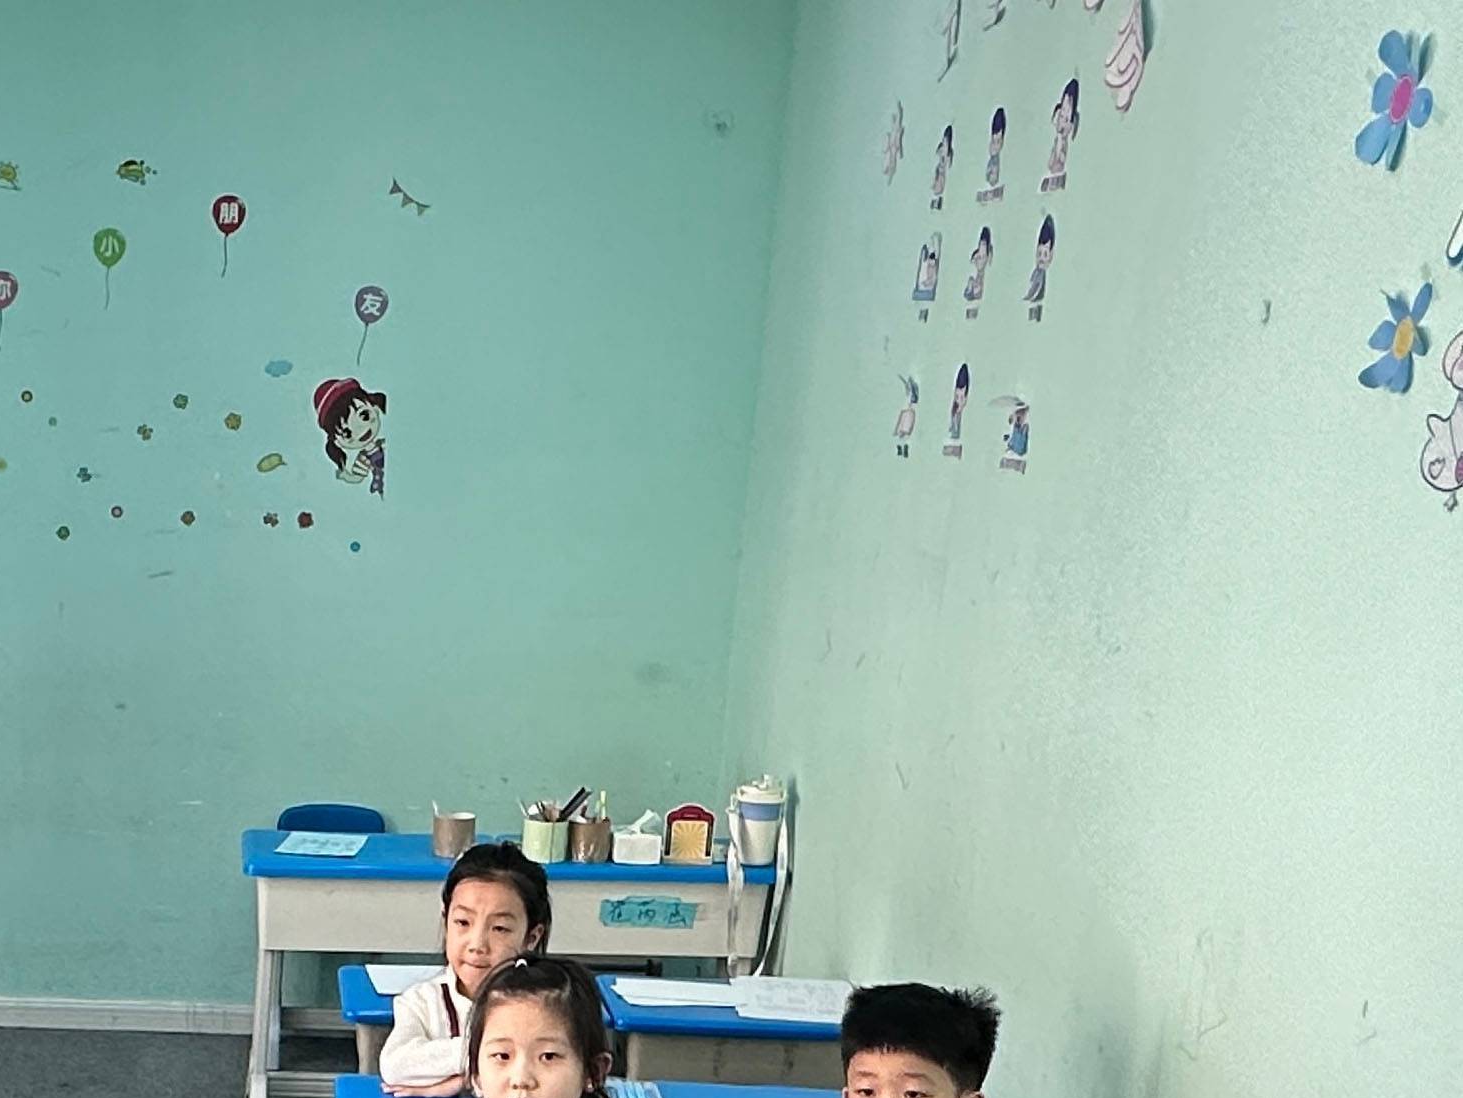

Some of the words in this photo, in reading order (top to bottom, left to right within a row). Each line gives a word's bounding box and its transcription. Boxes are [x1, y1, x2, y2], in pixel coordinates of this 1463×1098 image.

[99, 235, 120, 257] 小
[219, 202, 239, 224] 朋
[360, 293, 383, 316] 友
